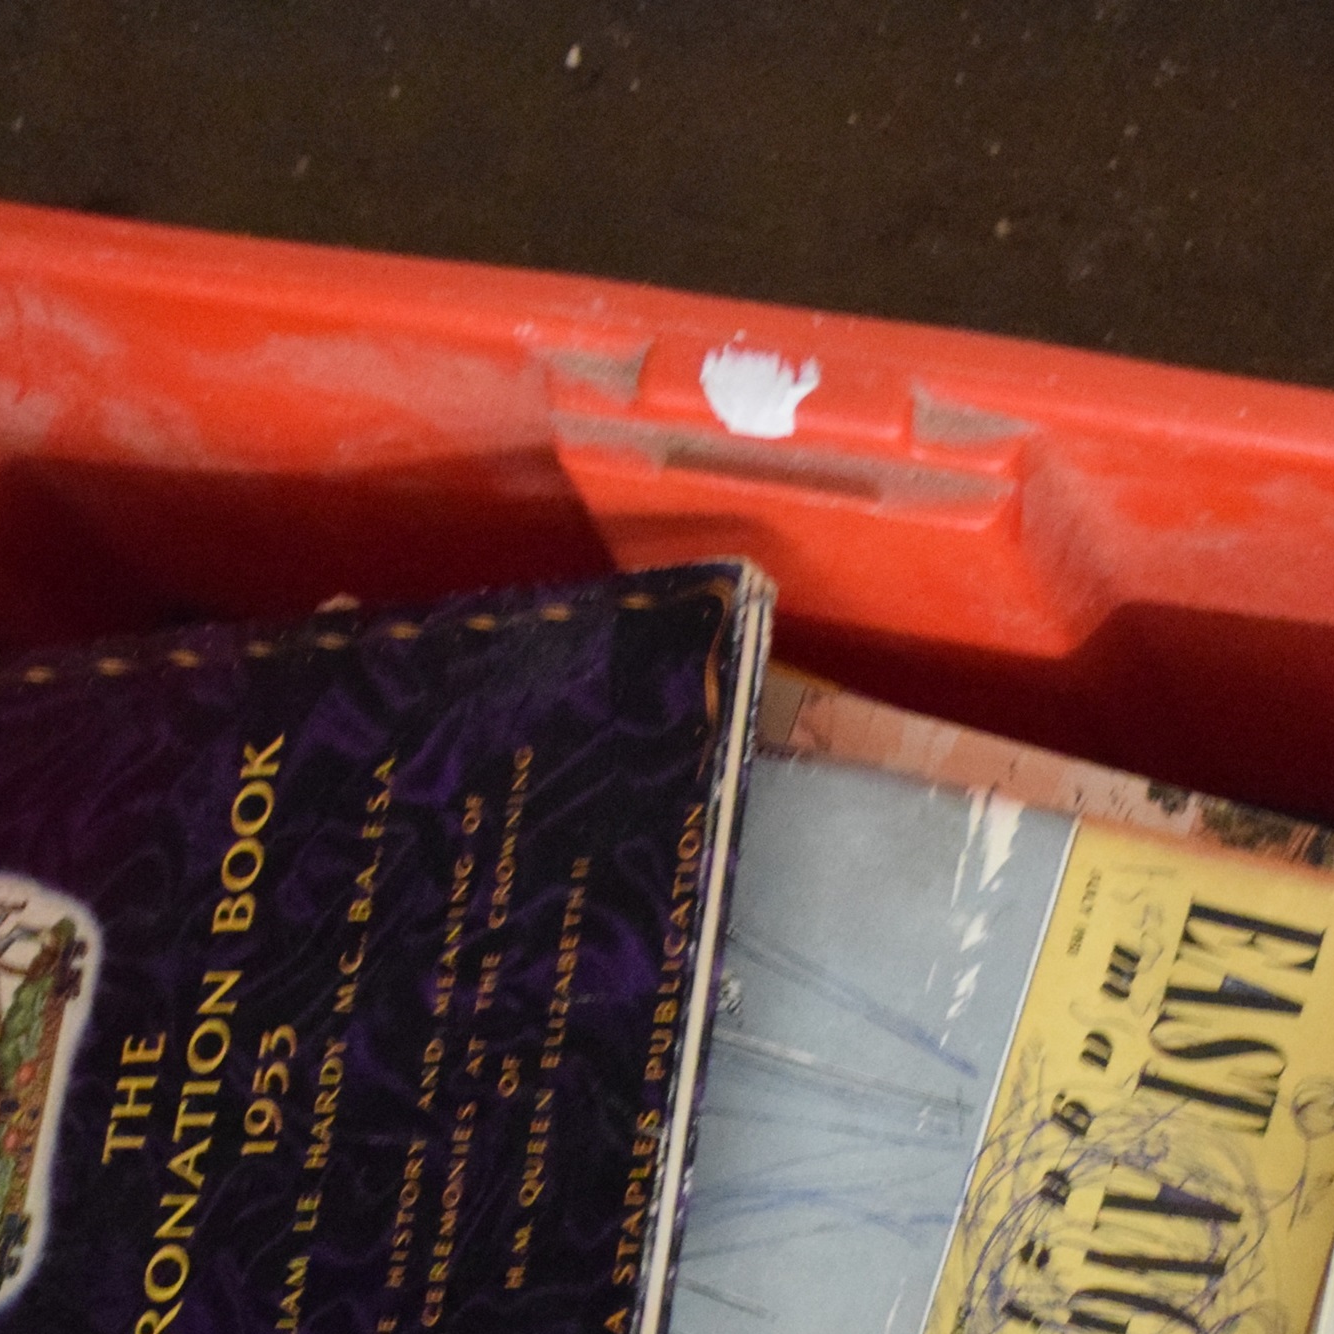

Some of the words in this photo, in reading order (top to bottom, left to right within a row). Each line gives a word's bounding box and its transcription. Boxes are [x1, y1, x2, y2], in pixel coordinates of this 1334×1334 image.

[211, 732, 285, 934] BOOK
[487, 744, 534, 929] CROWNING
[385, 1138, 428, 1289] HISTORY
[417, 1039, 445, 1111] AND
[431, 851, 476, 1018] MEANING
[461, 792, 485, 836] OF
[465, 1034, 488, 1077] AT
[473, 951, 502, 1013] THE
[517, 1088, 556, 1208] QUEEN
[539, 885, 585, 1070] ELIZABETH
[611, 1106, 662, 1286] STAPLES
[642, 800, 706, 1082] PUBLICATION
[1132, 898, 1327, 1138] EAST
[102, 1034, 167, 1164] THE
[240, 1024, 297, 1156] 1953
[303, 1038, 348, 1170] HARDY
[496, 1052, 519, 1098] OF
[292, 1191, 323, 1232] LE
[419, 1100, 479, 1328] CEREMONIES
